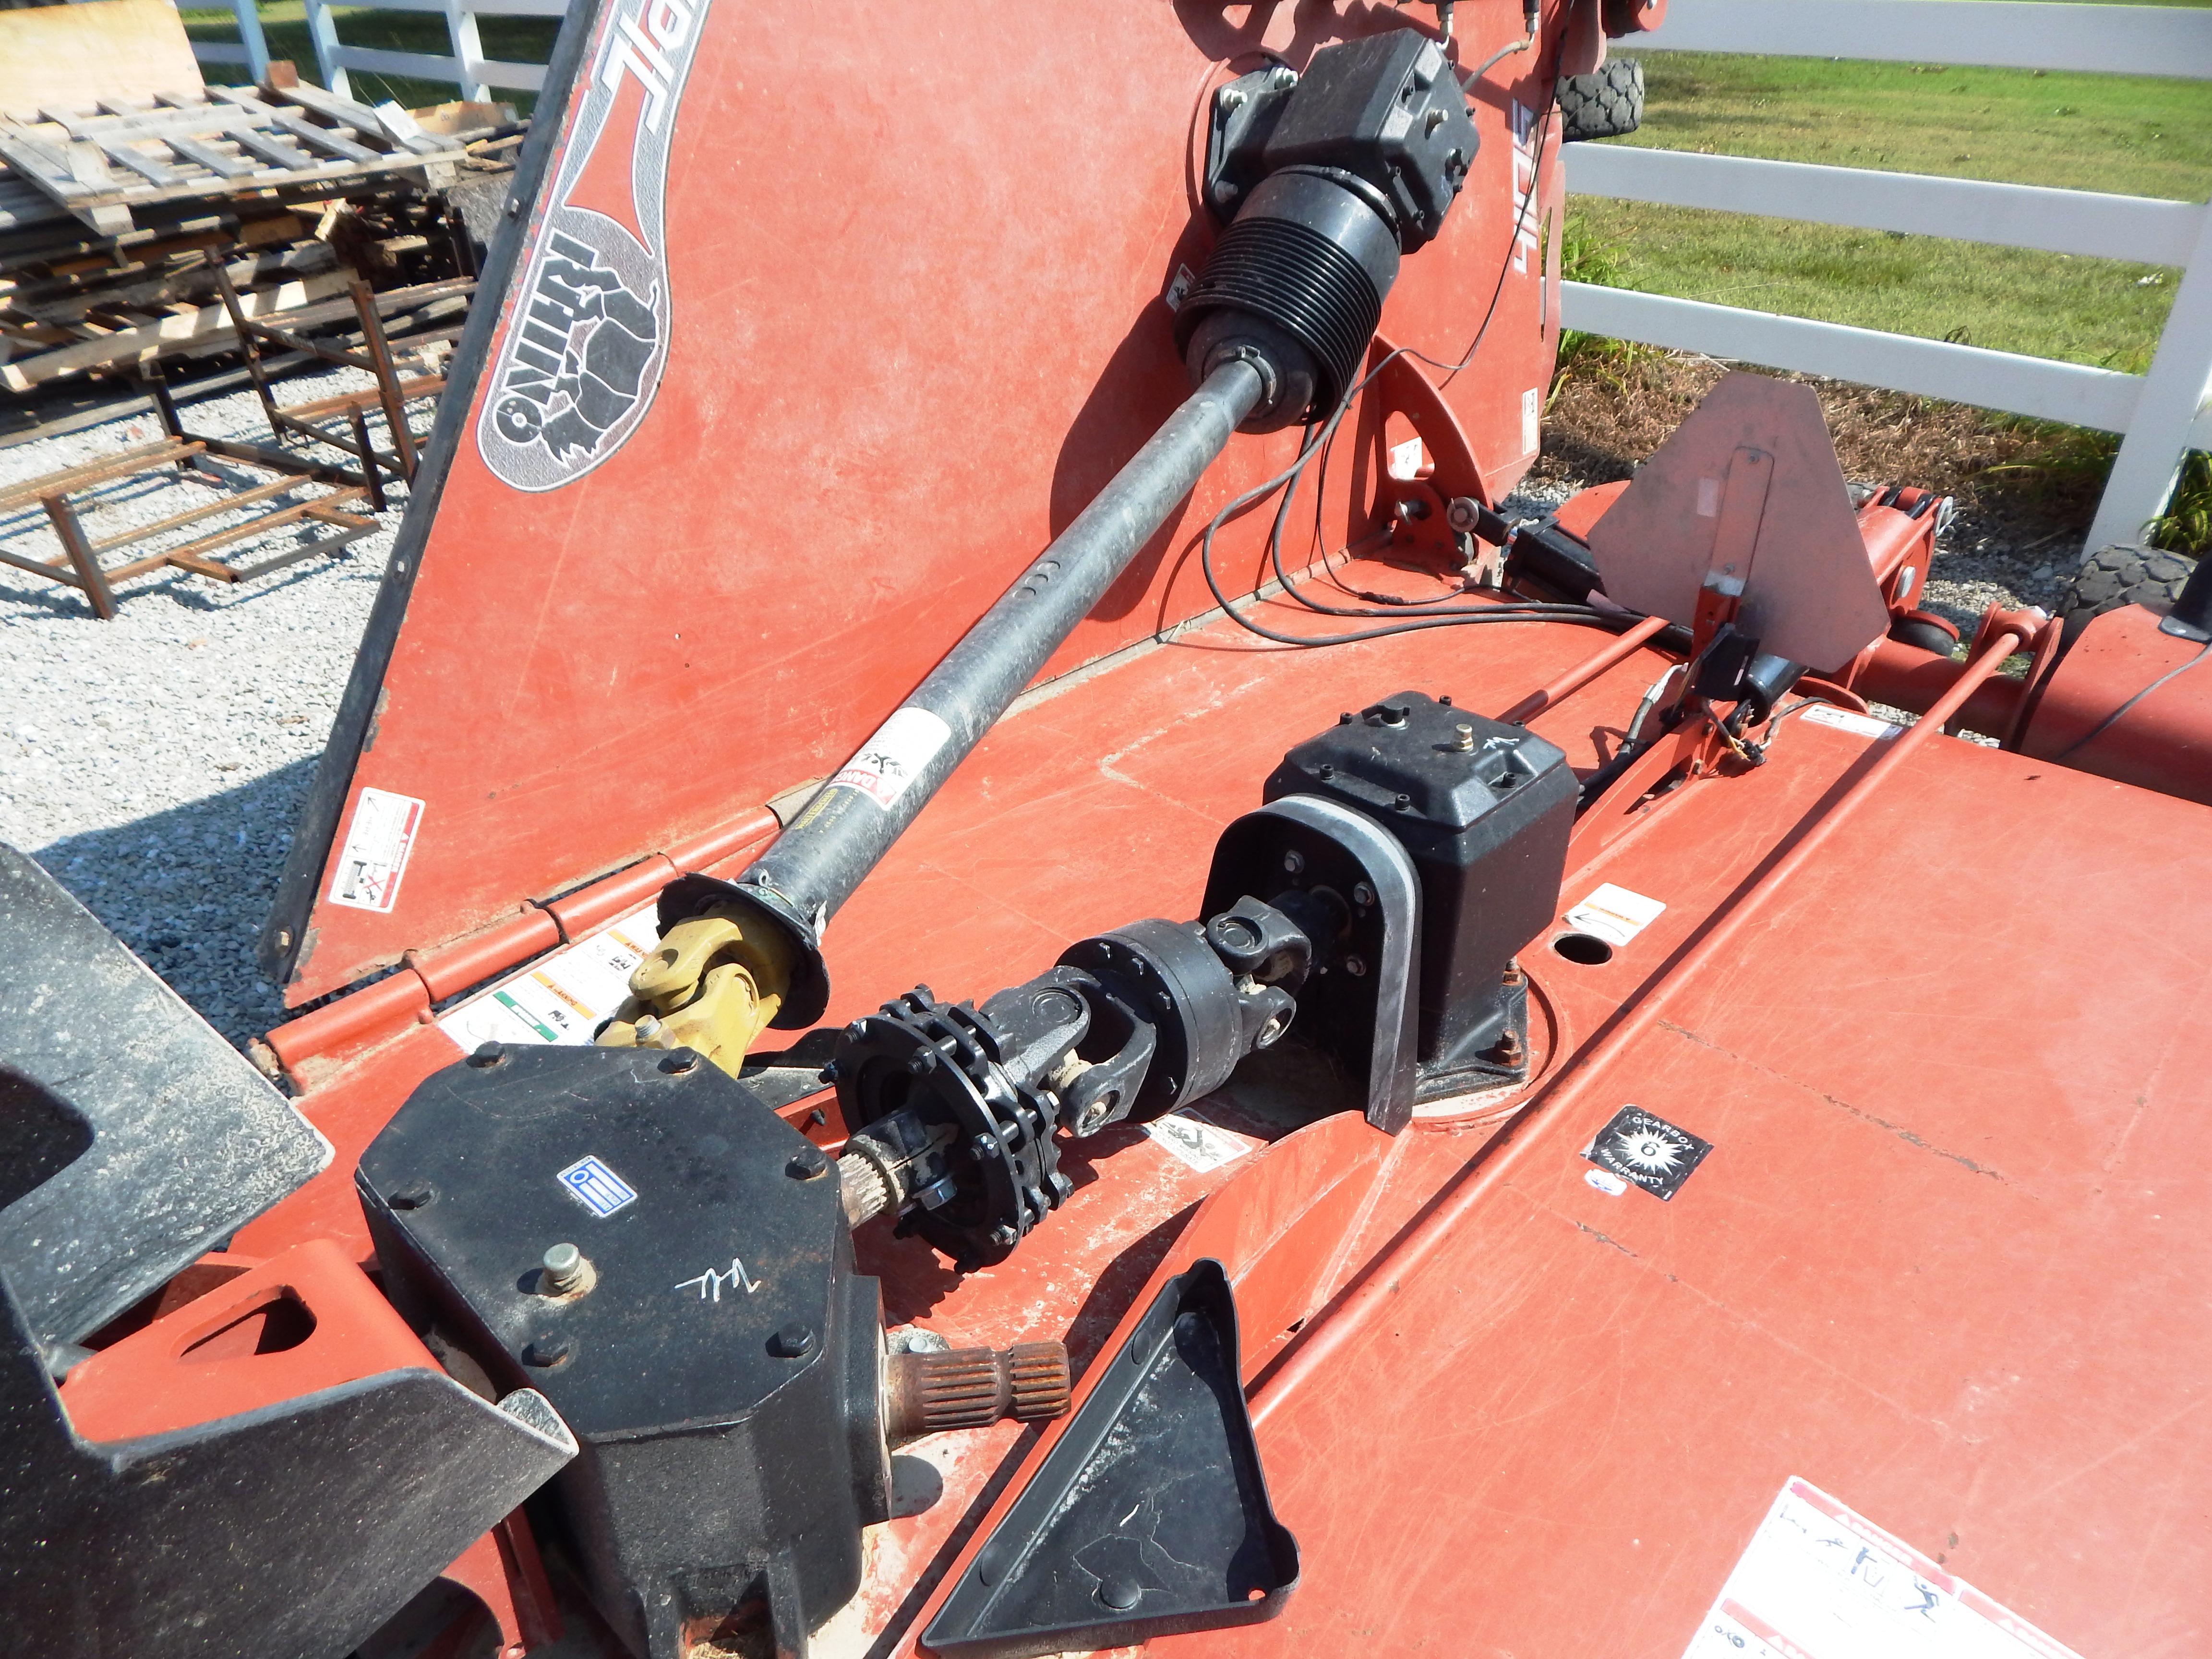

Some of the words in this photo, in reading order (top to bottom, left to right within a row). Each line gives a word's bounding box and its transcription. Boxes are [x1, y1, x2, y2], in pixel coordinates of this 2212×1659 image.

[600, 0, 700, 136] PIC
[391, 842, 406, 873] DANGER
[1633, 1117, 1695, 1150] GEARBOX
[1641, 1141, 1660, 1156] 6
[1601, 1148, 1663, 1185] WARRANTY
